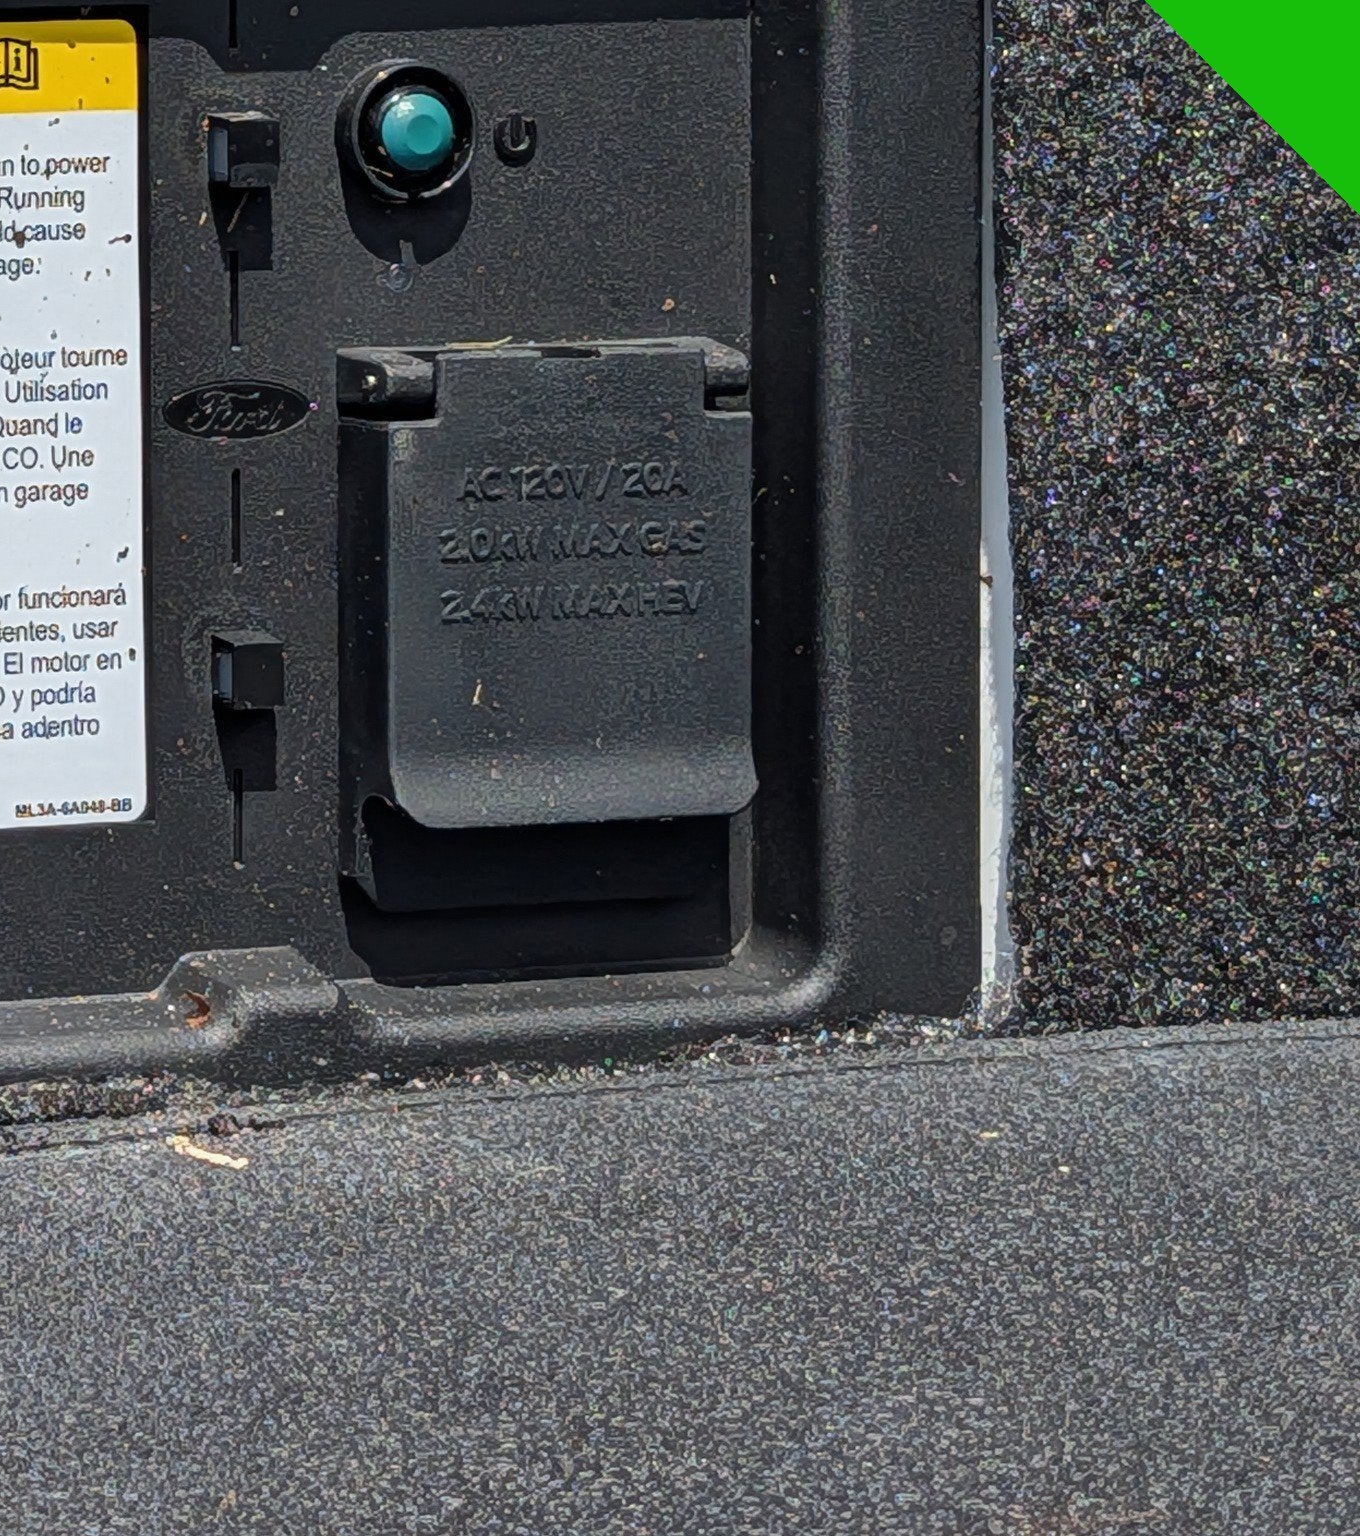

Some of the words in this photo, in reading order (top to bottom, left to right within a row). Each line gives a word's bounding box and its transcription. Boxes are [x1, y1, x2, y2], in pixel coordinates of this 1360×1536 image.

[21, 155, 40, 175] to
[45, 156, 110, 180] power
[22, 223, 86, 242] cause
[61, 347, 127, 367] tourne
[5, 379, 108, 403] Utilisation
[65, 412, 82, 434] le
[185, 391, 284, 432] Ford
[3, 447, 43, 469] CO.
[51, 446, 94, 469] Une
[456, 467, 504, 501] AC
[510, 464, 589, 501] 120V
[620, 461, 689, 499] 20A
[14, 483, 88, 508] garage
[551, 524, 634, 561] MAX
[637, 520, 709, 558] GAS
[18, 583, 126, 609] funcionará
[551, 583, 634, 622] MAX
[637, 578, 705, 617] HEV
[73, 621, 118, 639] usar
[4, 652, 23, 675] El
[31, 651, 89, 673] motor
[97, 653, 121, 670] en
[12, 690, 23, 713] y
[31, 682, 96, 711] podría
[22, 715, 100, 739] adentro
